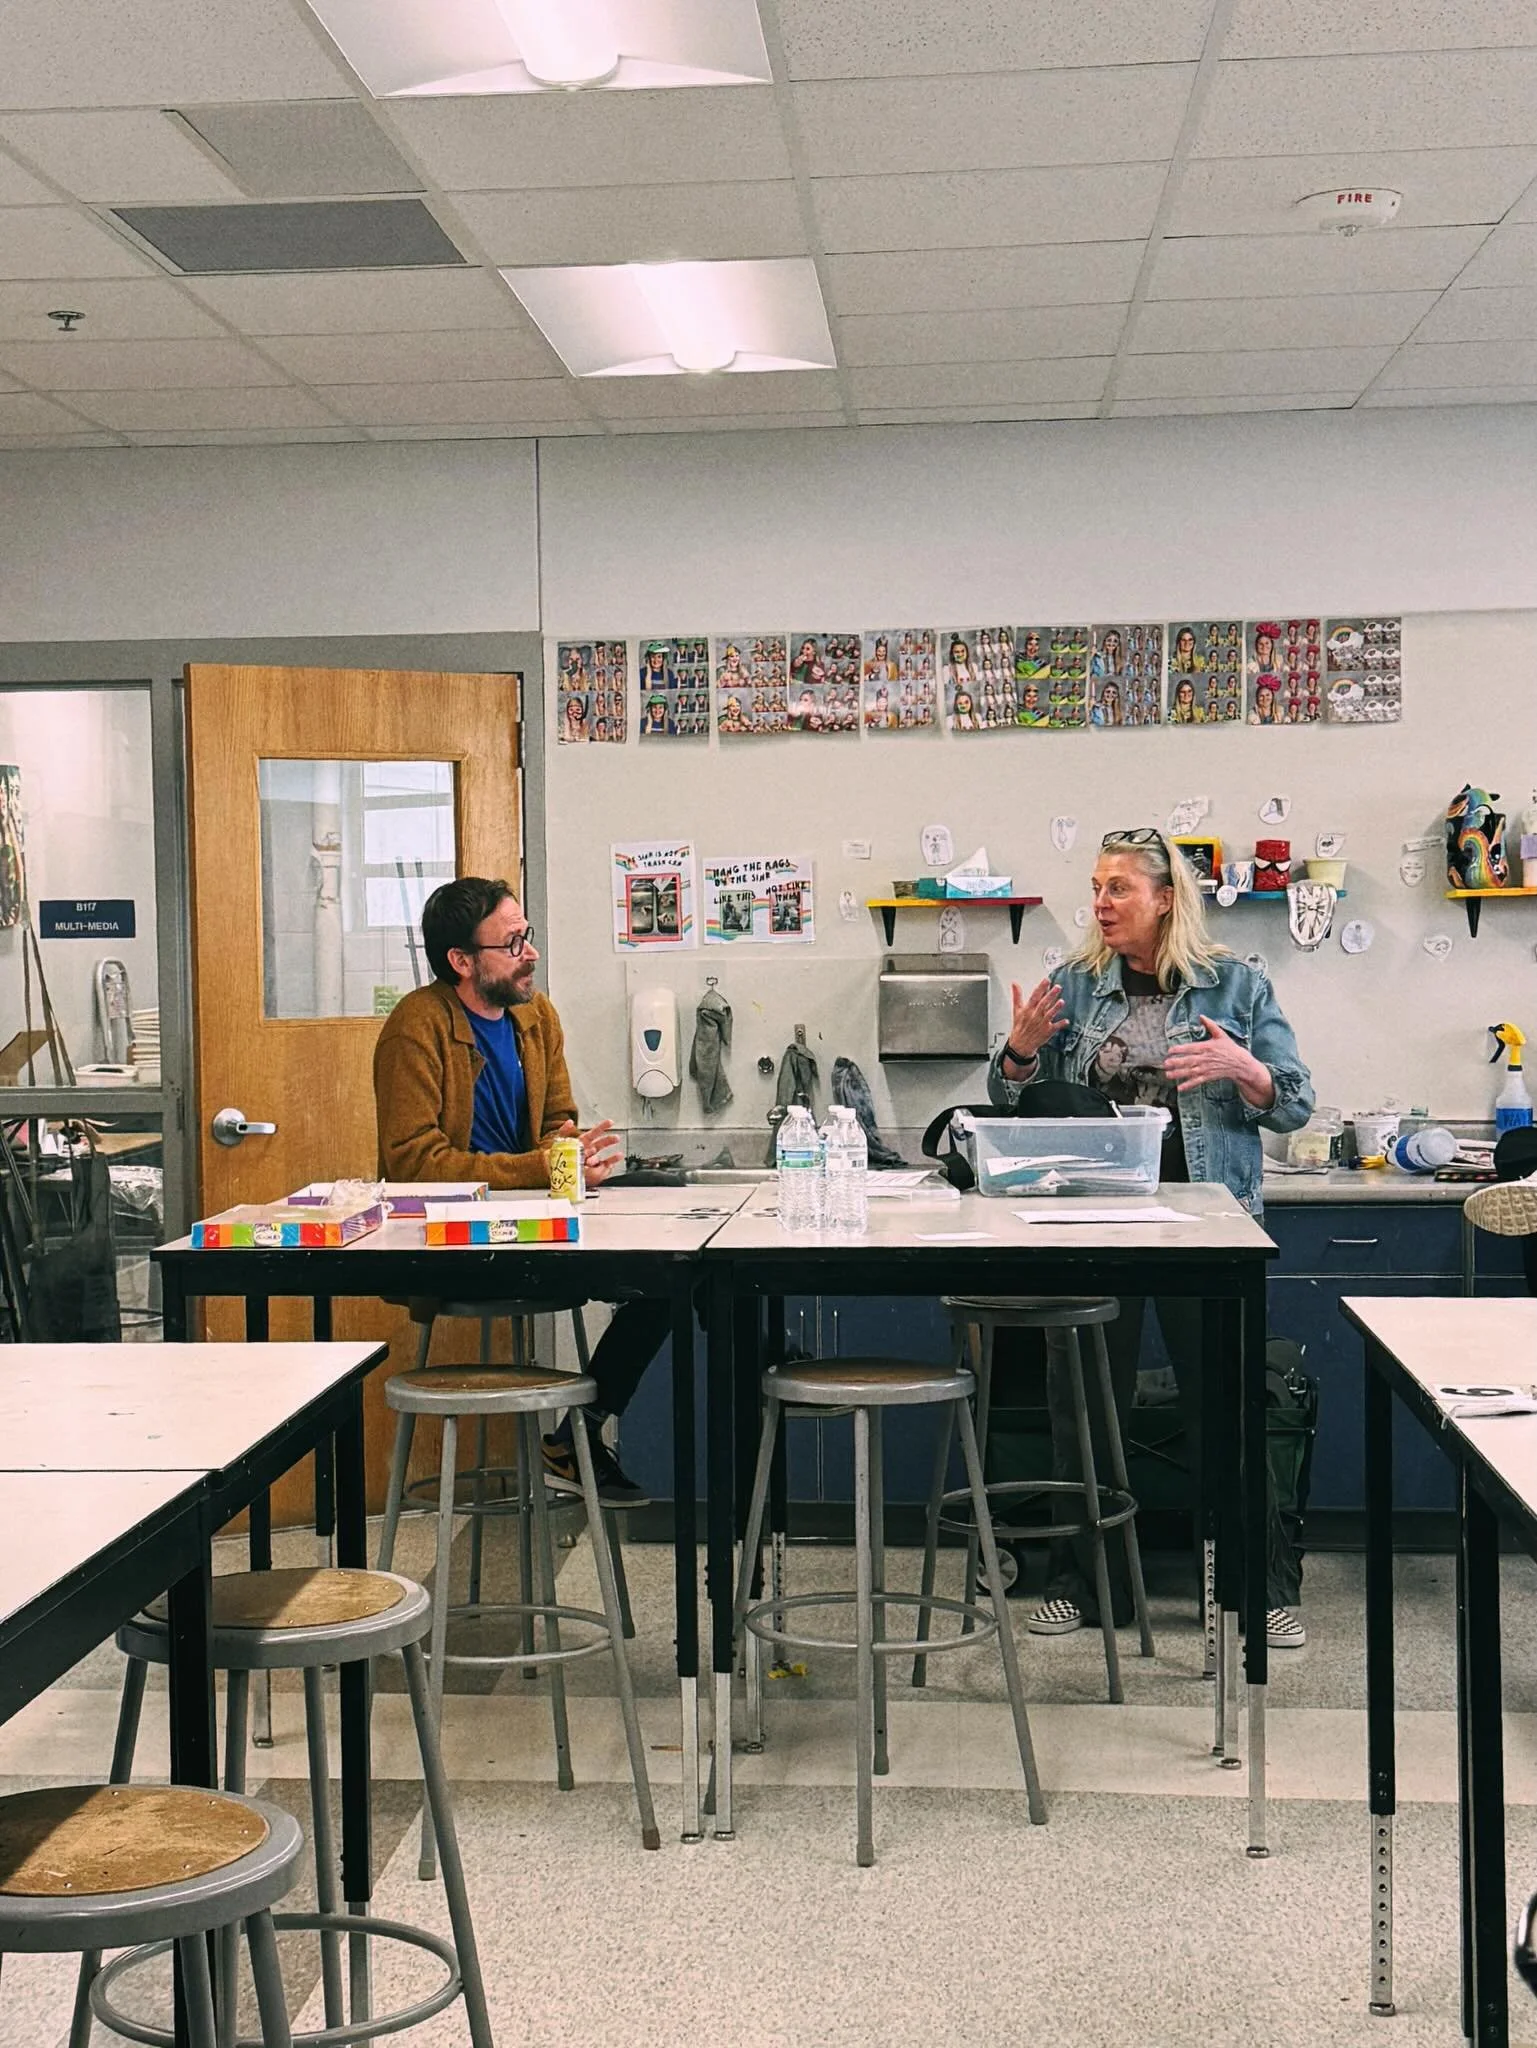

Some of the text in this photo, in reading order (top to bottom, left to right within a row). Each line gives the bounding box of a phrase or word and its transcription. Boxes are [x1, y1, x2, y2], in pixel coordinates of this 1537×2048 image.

[1337, 193, 1372, 204] FIRE
[655, 850, 662, 858] IS
[713, 858, 791, 879] HANG THE RAGS
[731, 874, 747, 884] THE
[751, 871, 771, 882] SINK
[714, 892, 756, 905] LIKE THIS
[76, 902, 97, 911] B117
[55, 922, 119, 931] MULTI-MEDIA
